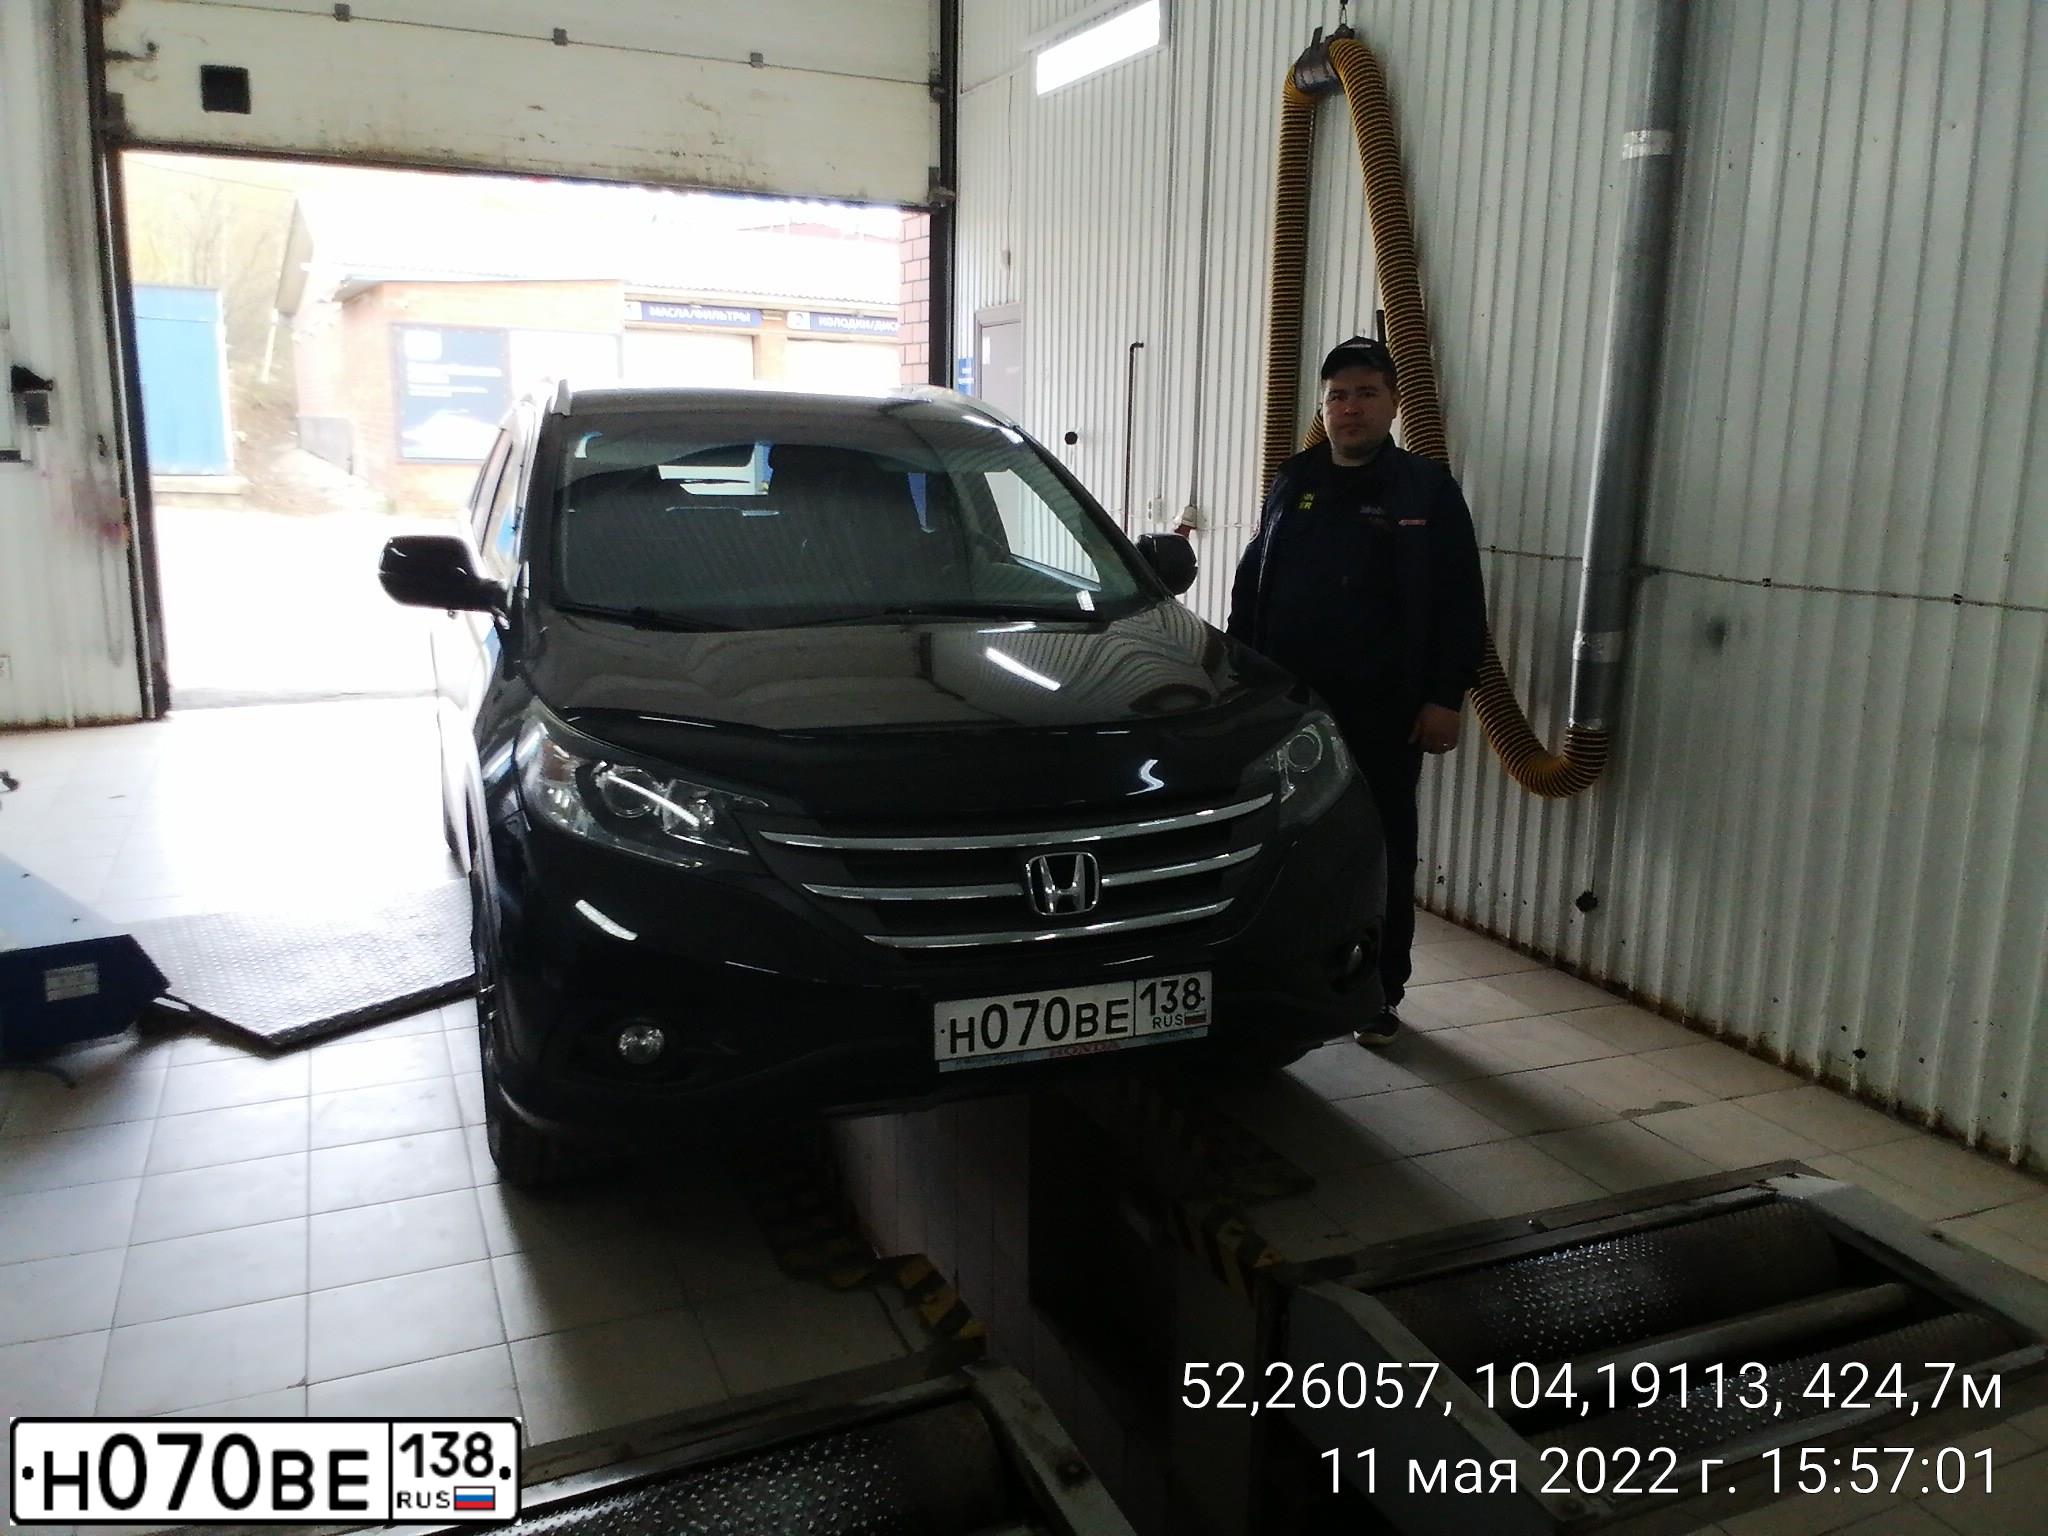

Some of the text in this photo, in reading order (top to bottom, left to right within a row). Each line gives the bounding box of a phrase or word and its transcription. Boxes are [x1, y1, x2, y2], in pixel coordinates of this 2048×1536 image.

[818, 315, 900, 333] КОЛОДКИ/ДИС
[949, 976, 1202, 1054] Н070ВЕ 138
[1152, 1013, 1184, 1030] RUS
